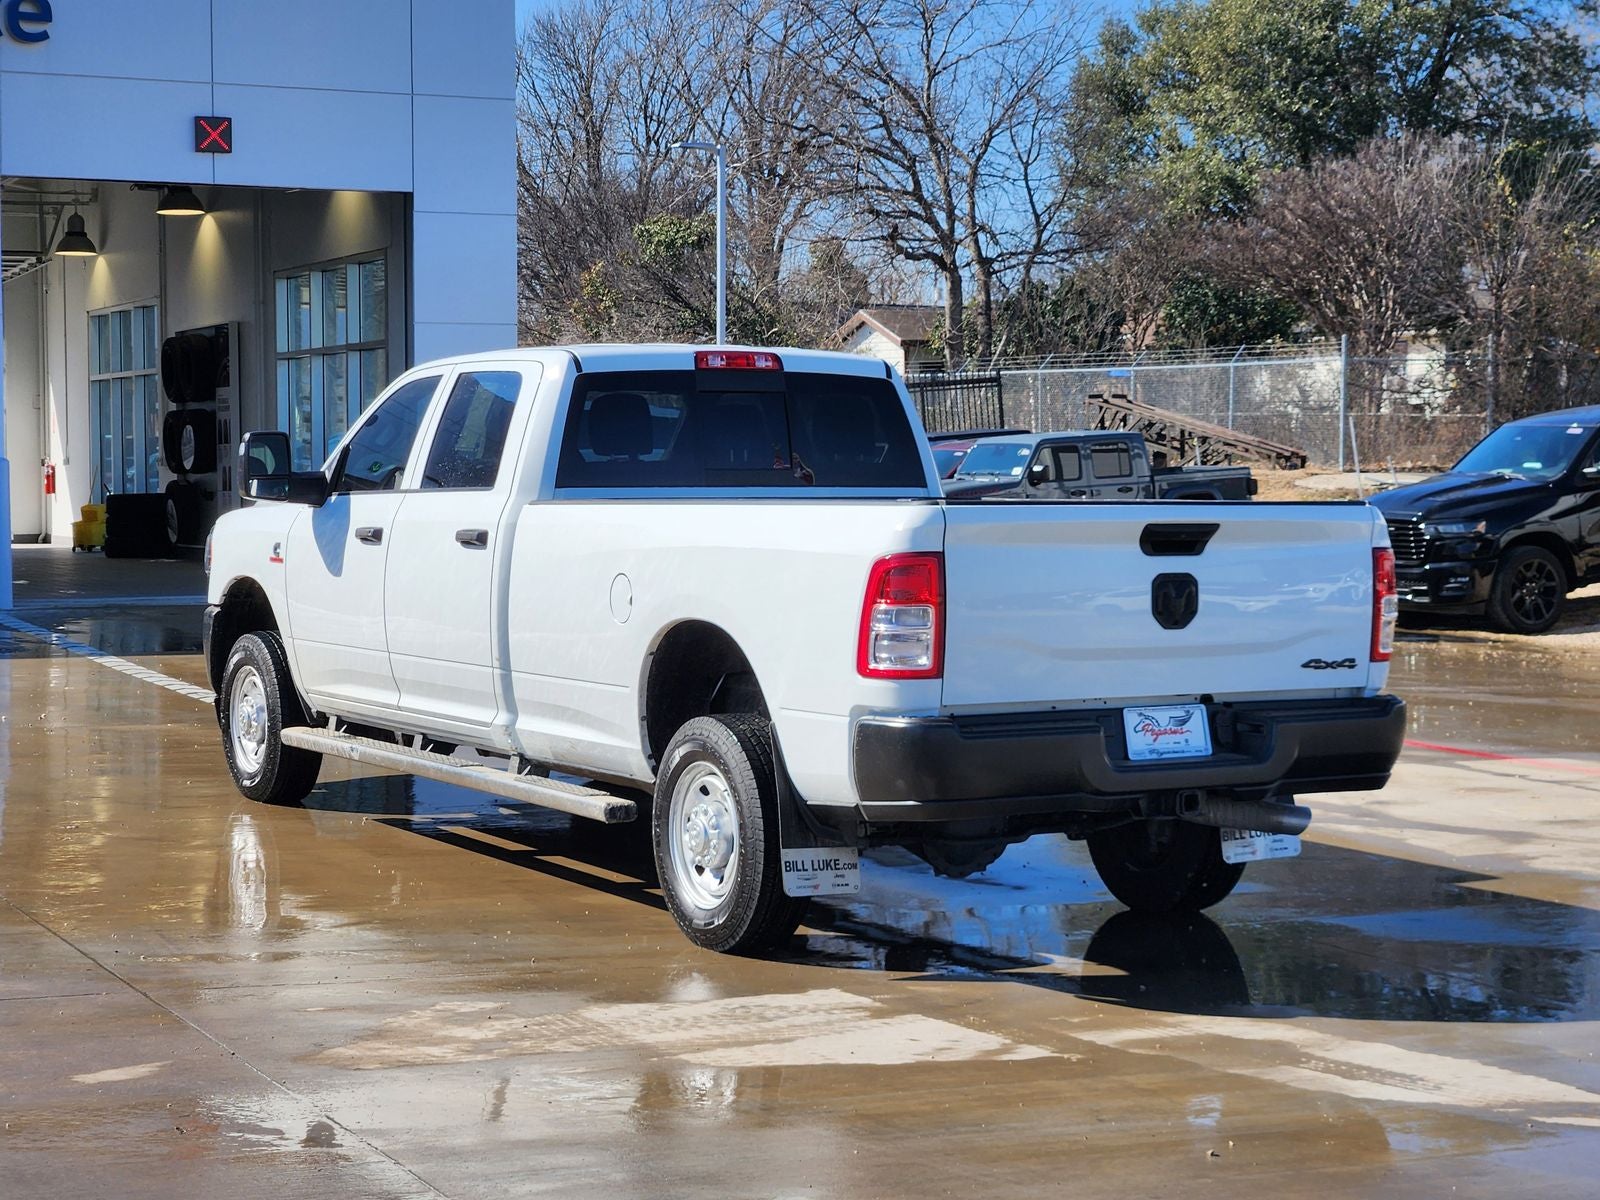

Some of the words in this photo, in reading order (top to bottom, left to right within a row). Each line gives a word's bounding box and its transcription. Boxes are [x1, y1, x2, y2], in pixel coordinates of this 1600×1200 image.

[1300, 658, 1358, 669] 4x4
[1141, 722, 1192, 742] Pegasus
[1222, 830, 1246, 842] BILL
[784, 860, 808, 872] BILL
